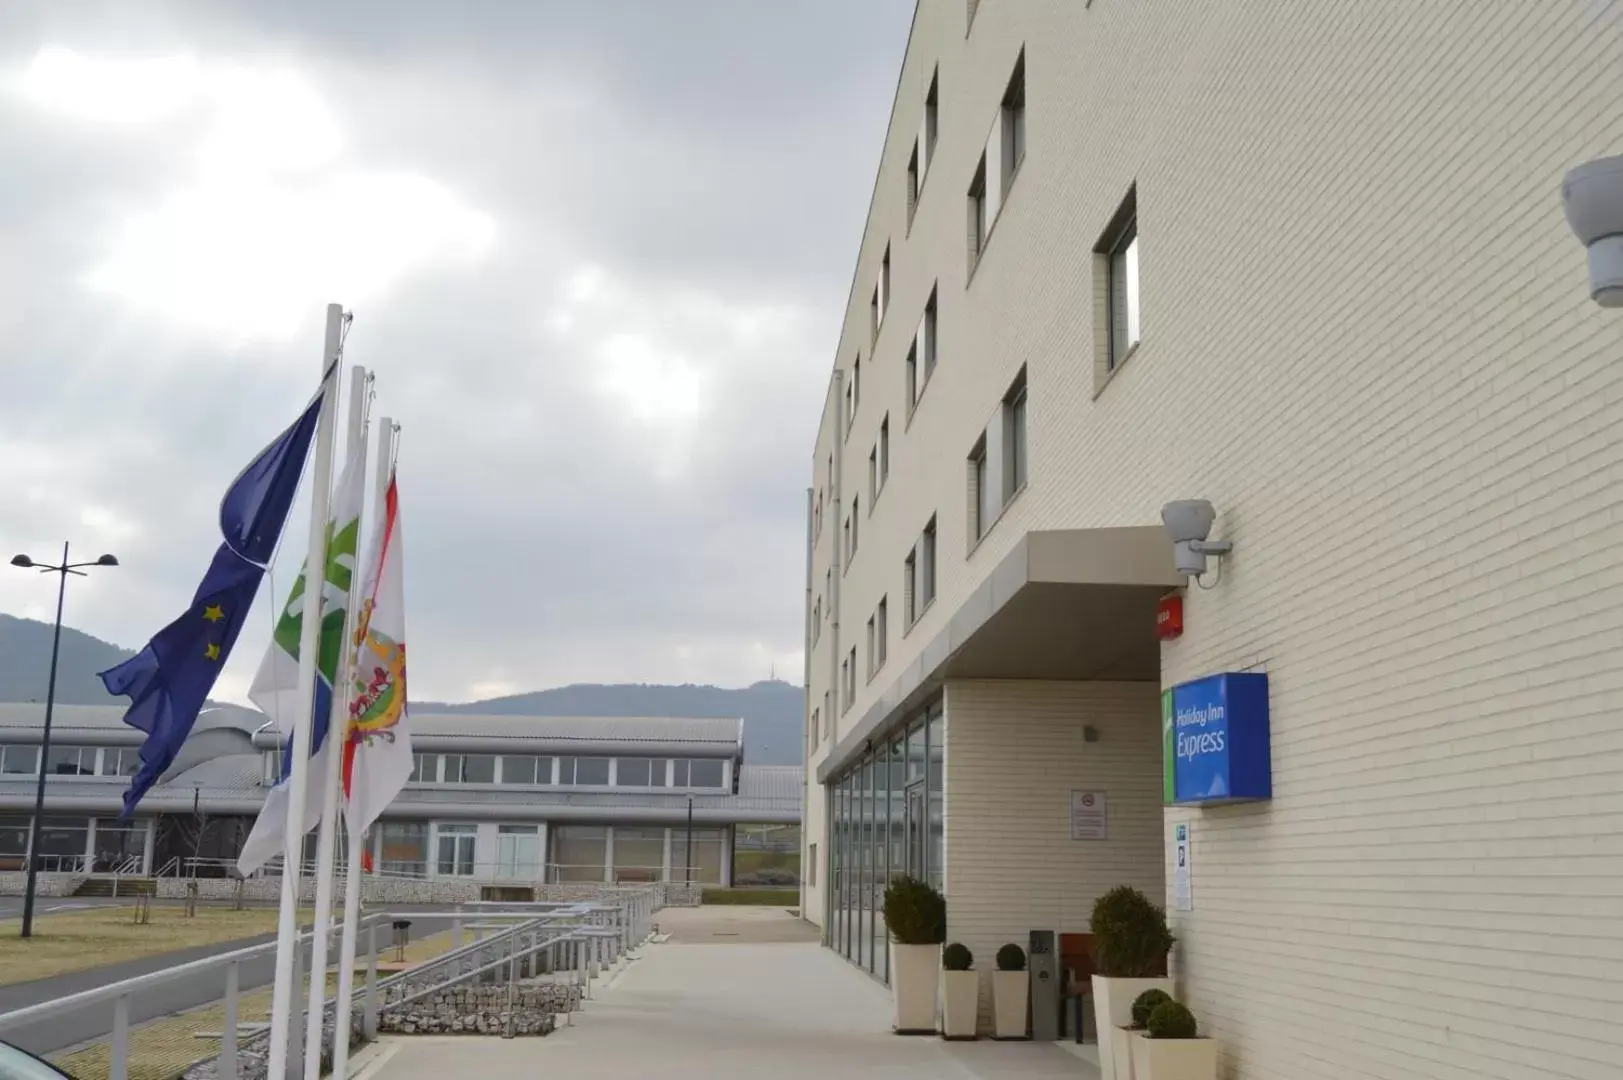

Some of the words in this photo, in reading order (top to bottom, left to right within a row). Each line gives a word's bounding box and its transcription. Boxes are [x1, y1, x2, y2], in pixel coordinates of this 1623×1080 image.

[1177, 704, 1207, 727] Holiday
[1207, 702, 1224, 720] Inn
[1177, 730, 1224, 762] Express
